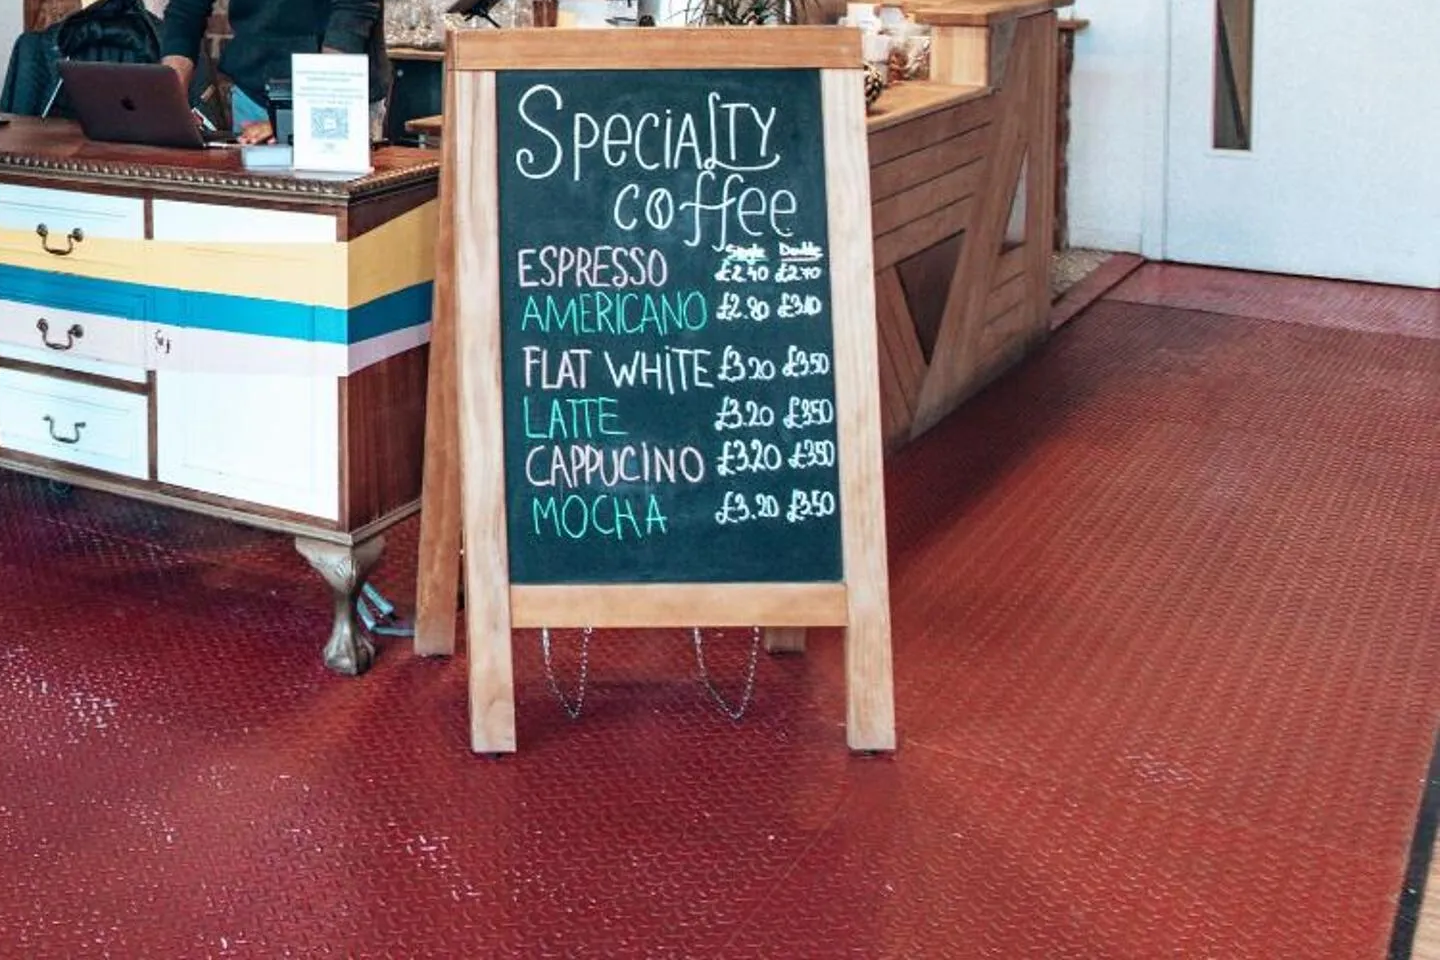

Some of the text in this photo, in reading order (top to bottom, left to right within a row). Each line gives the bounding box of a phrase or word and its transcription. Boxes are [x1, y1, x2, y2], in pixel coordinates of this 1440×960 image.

[517, 244, 669, 289] ESPRESSO
[521, 290, 709, 337] AMERICANO
[522, 344, 593, 390] FLAT
[523, 395, 630, 441] LATTE
[525, 441, 706, 491] CAPPUCINO
[532, 493, 669, 540] MOCHA
